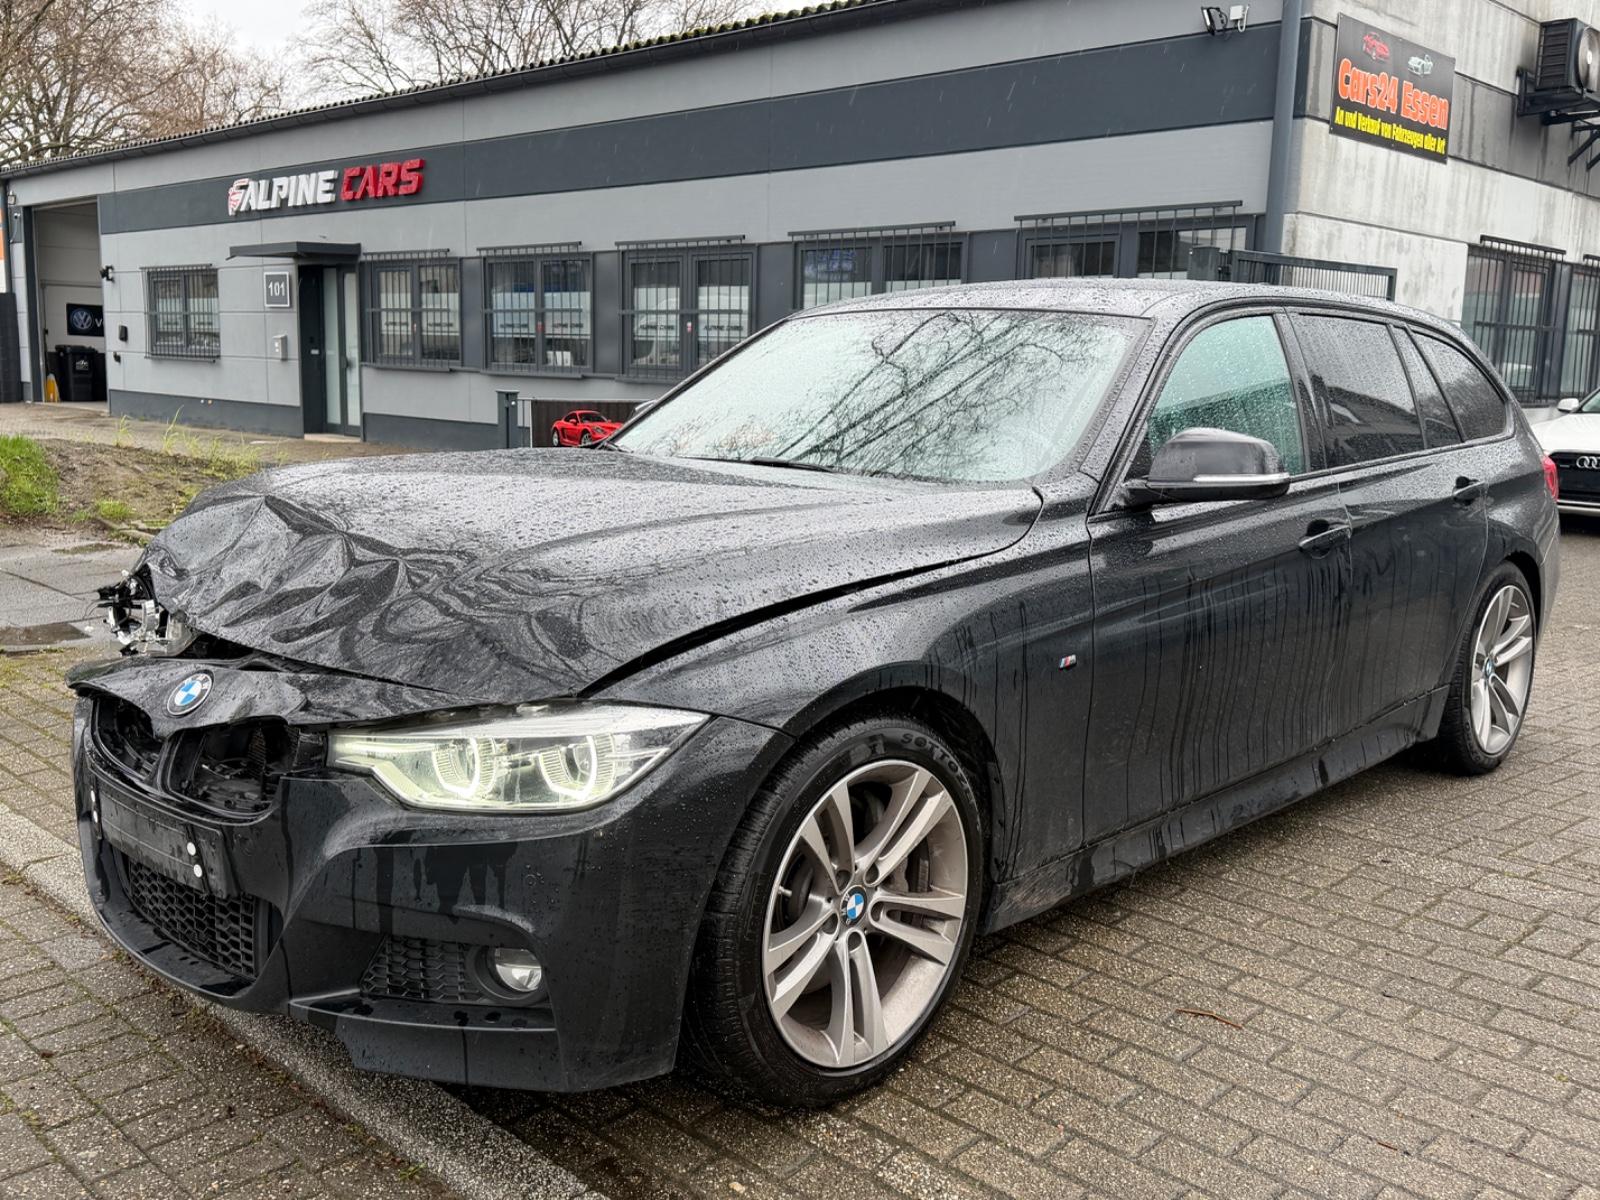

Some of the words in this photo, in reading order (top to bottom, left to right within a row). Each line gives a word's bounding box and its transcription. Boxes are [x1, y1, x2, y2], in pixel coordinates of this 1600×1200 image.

[1338, 58, 1399, 114] Cars24
[1401, 80, 1449, 130] Essen
[1334, 106, 1344, 125] An
[1345, 111, 1357, 129] und
[1358, 112, 1381, 136] Verkauf
[1381, 121, 1392, 139] von
[1392, 123, 1424, 149] Fahrzeugen
[1437, 137, 1446, 155] Art
[238, 169, 338, 212] ALPINE
[340, 158, 425, 202] CARS
[268, 281, 286, 297] 101
